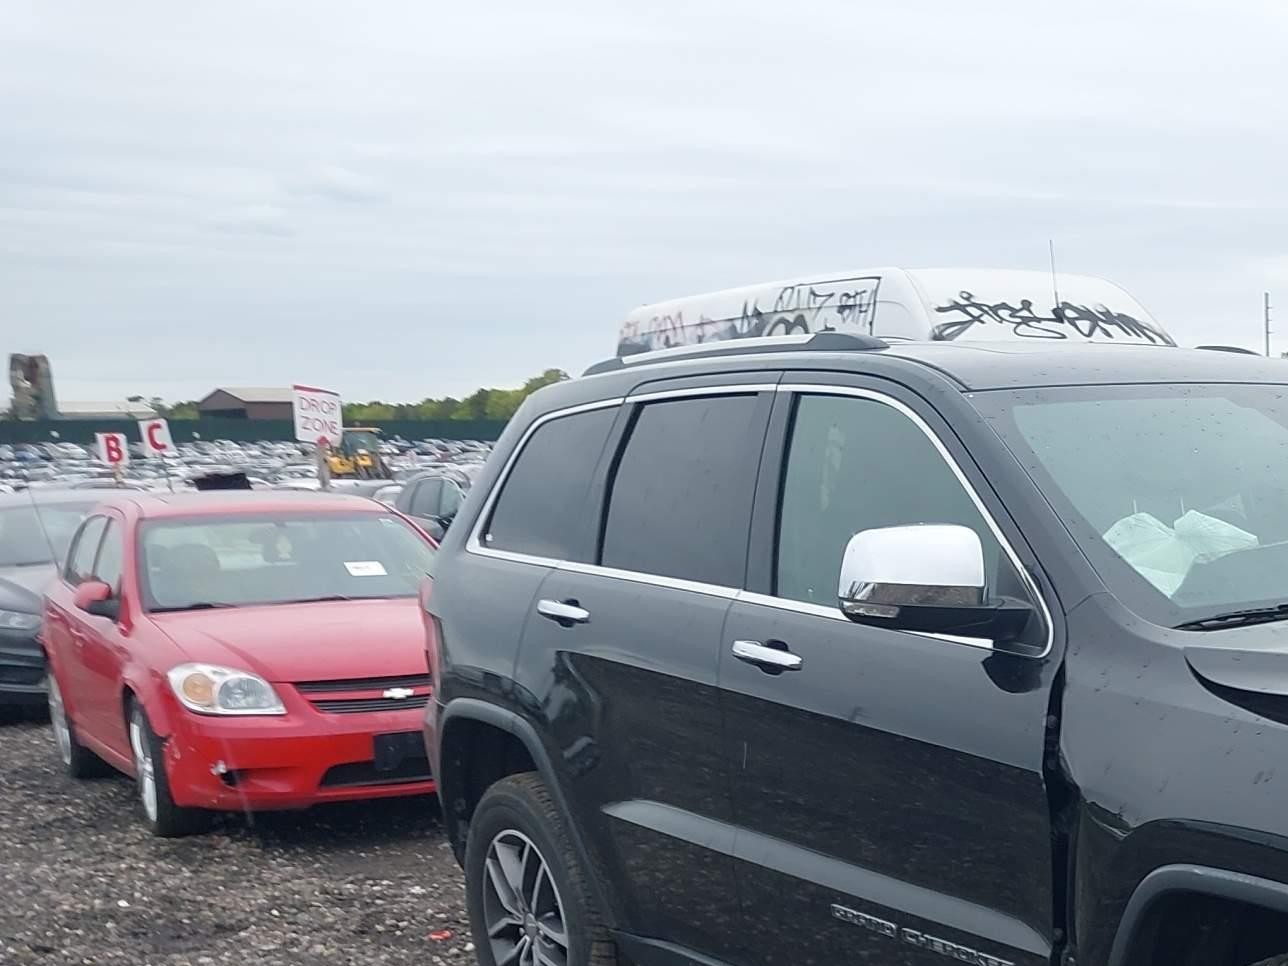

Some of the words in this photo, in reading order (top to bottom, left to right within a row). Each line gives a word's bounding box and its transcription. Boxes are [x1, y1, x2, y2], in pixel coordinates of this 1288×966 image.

[300, 397, 338, 415] DROP
[147, 423, 168, 451] C
[302, 415, 339, 436] ZONE
[104, 435, 123, 463] B
[830, 903, 897, 938] GRAND
